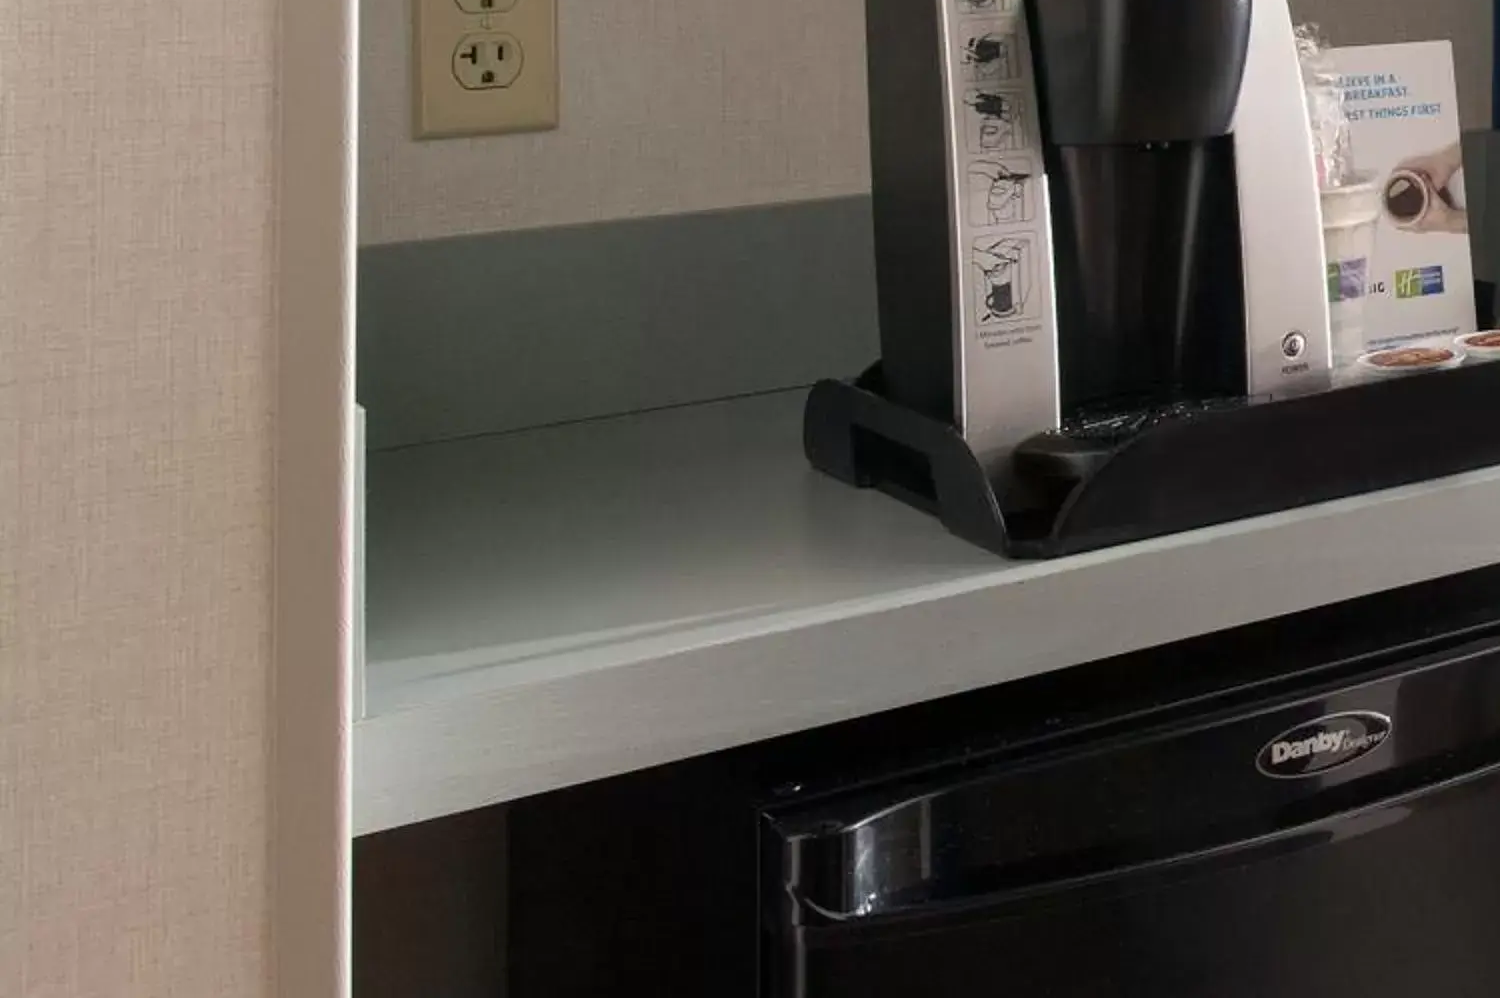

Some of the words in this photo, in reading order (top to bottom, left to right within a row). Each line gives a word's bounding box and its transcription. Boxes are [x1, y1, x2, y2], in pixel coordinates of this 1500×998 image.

[1368, 105, 1409, 120] THINGS
[1410, 103, 1441, 118] FIRST
[1271, 730, 1346, 765] Danby
